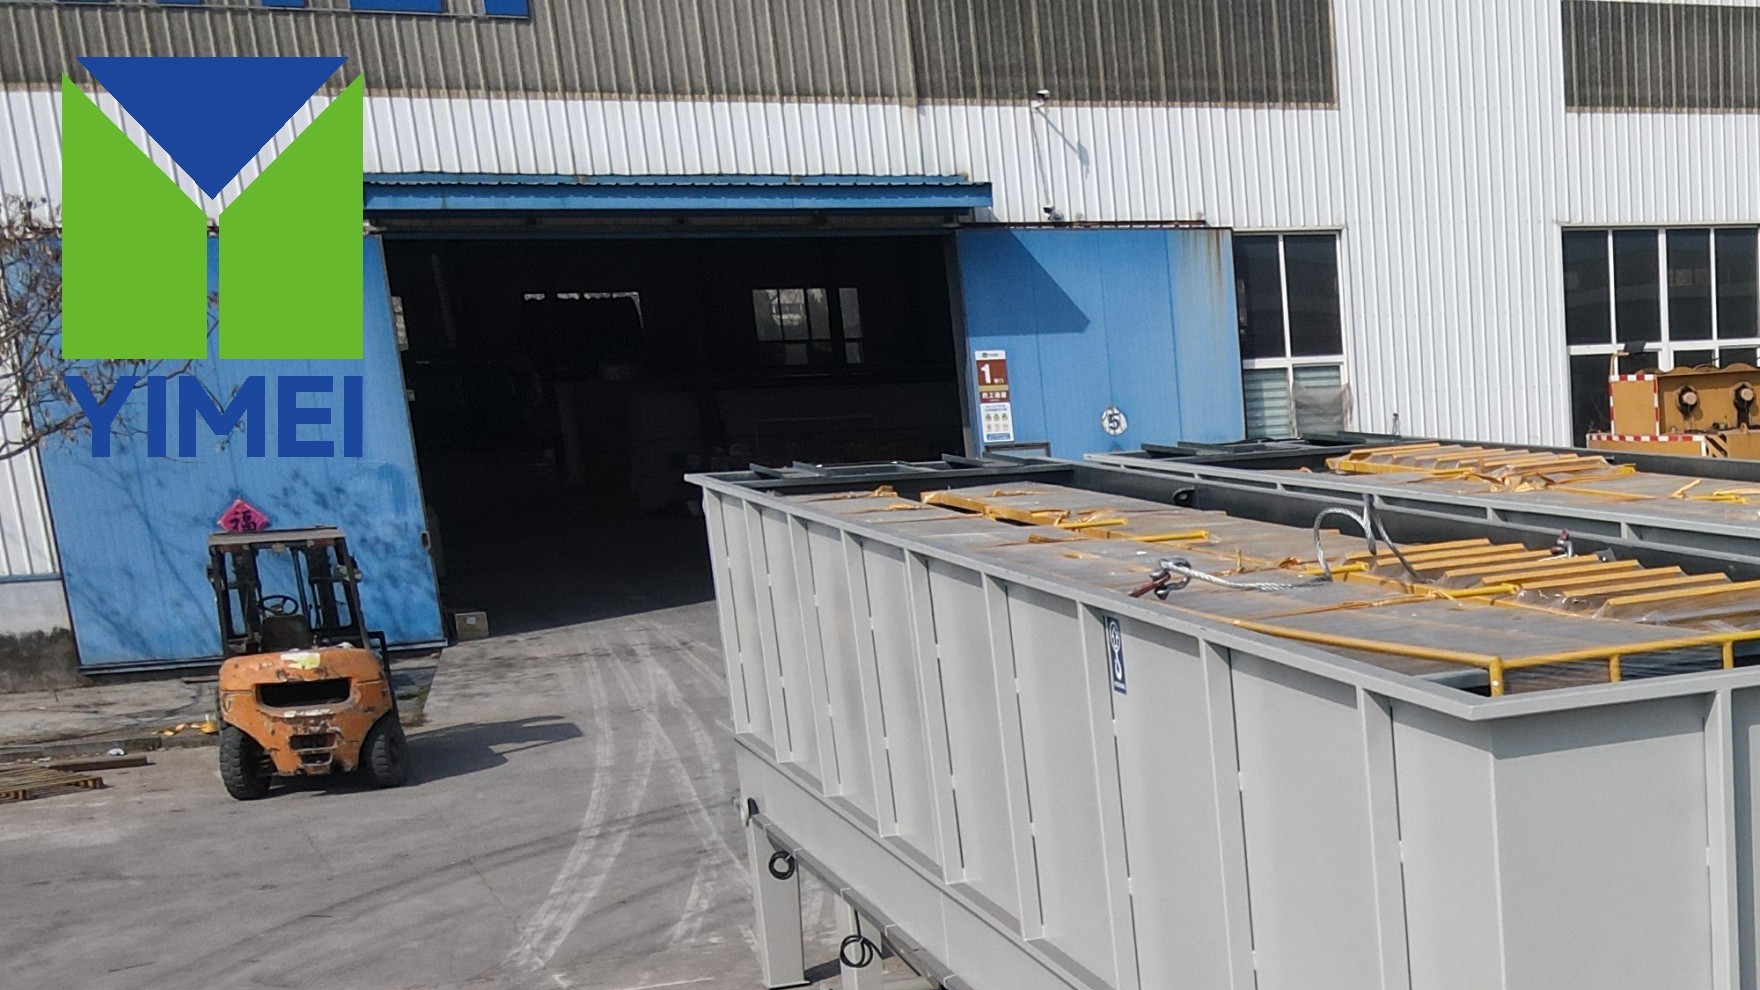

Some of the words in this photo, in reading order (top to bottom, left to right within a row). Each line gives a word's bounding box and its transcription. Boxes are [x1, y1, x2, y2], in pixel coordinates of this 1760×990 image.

[981, 363, 991, 384] 1
[1108, 413, 1121, 430] 5
[229, 510, 257, 532] 福
